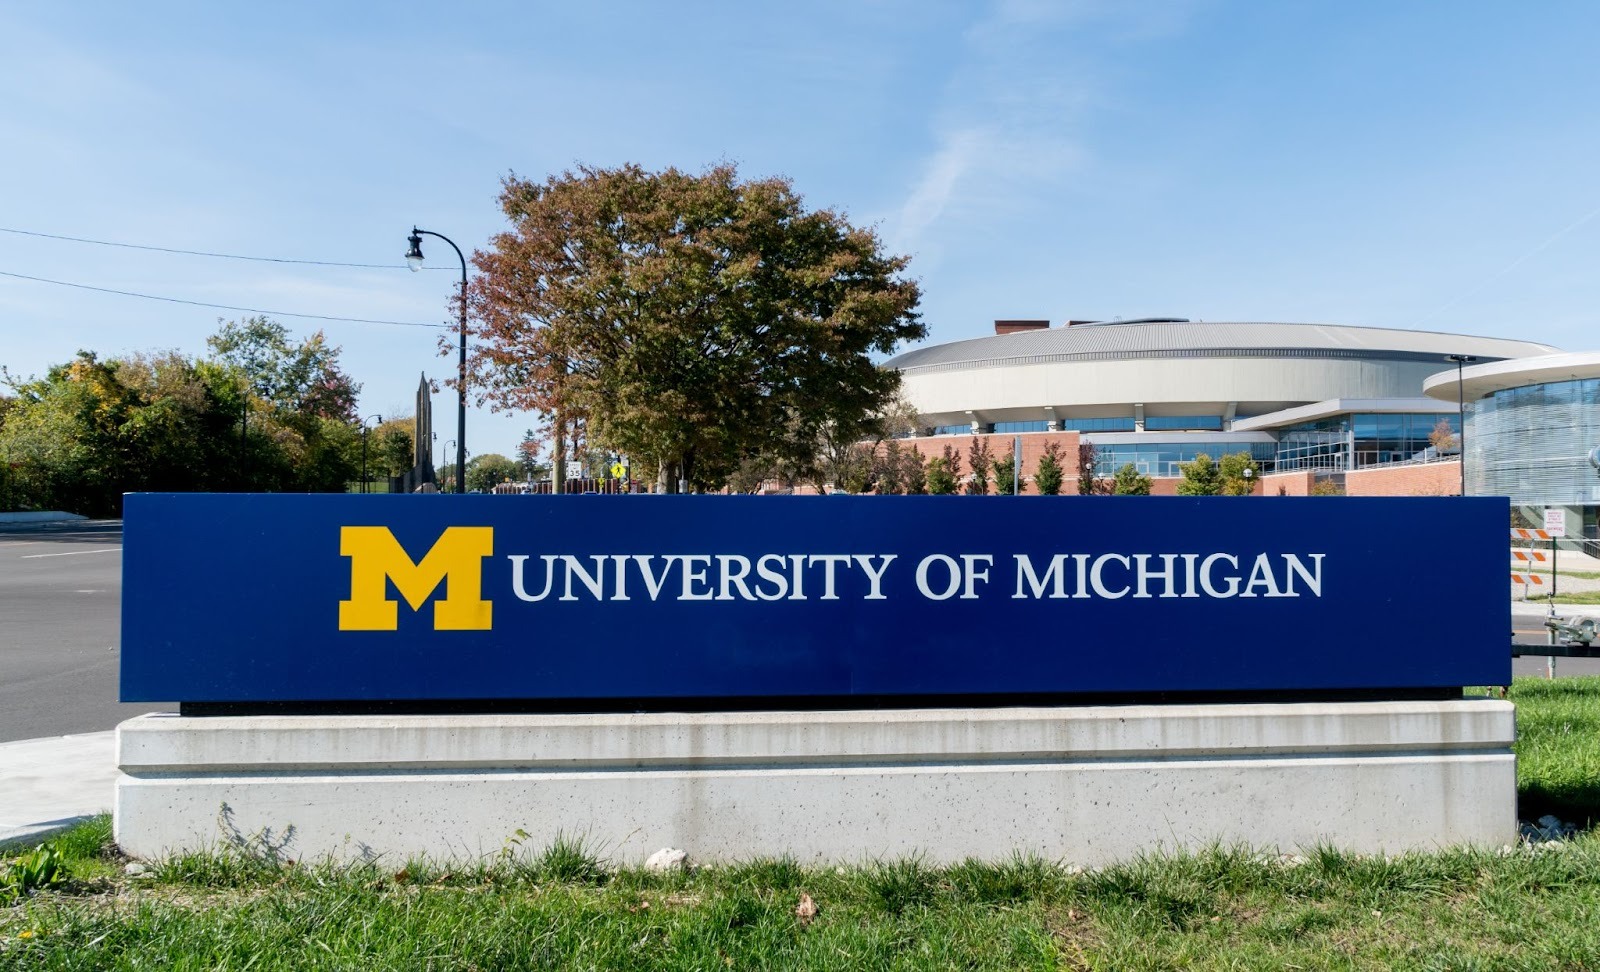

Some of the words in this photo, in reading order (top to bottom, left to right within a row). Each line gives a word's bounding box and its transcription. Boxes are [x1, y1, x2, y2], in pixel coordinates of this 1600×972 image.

[569, 469, 581, 477] 35
[338, 526, 494, 631] M
[508, 554, 898, 602] UNIVERSITY
[915, 554, 994, 601] OF
[1011, 552, 1326, 600] MICHIGAN
